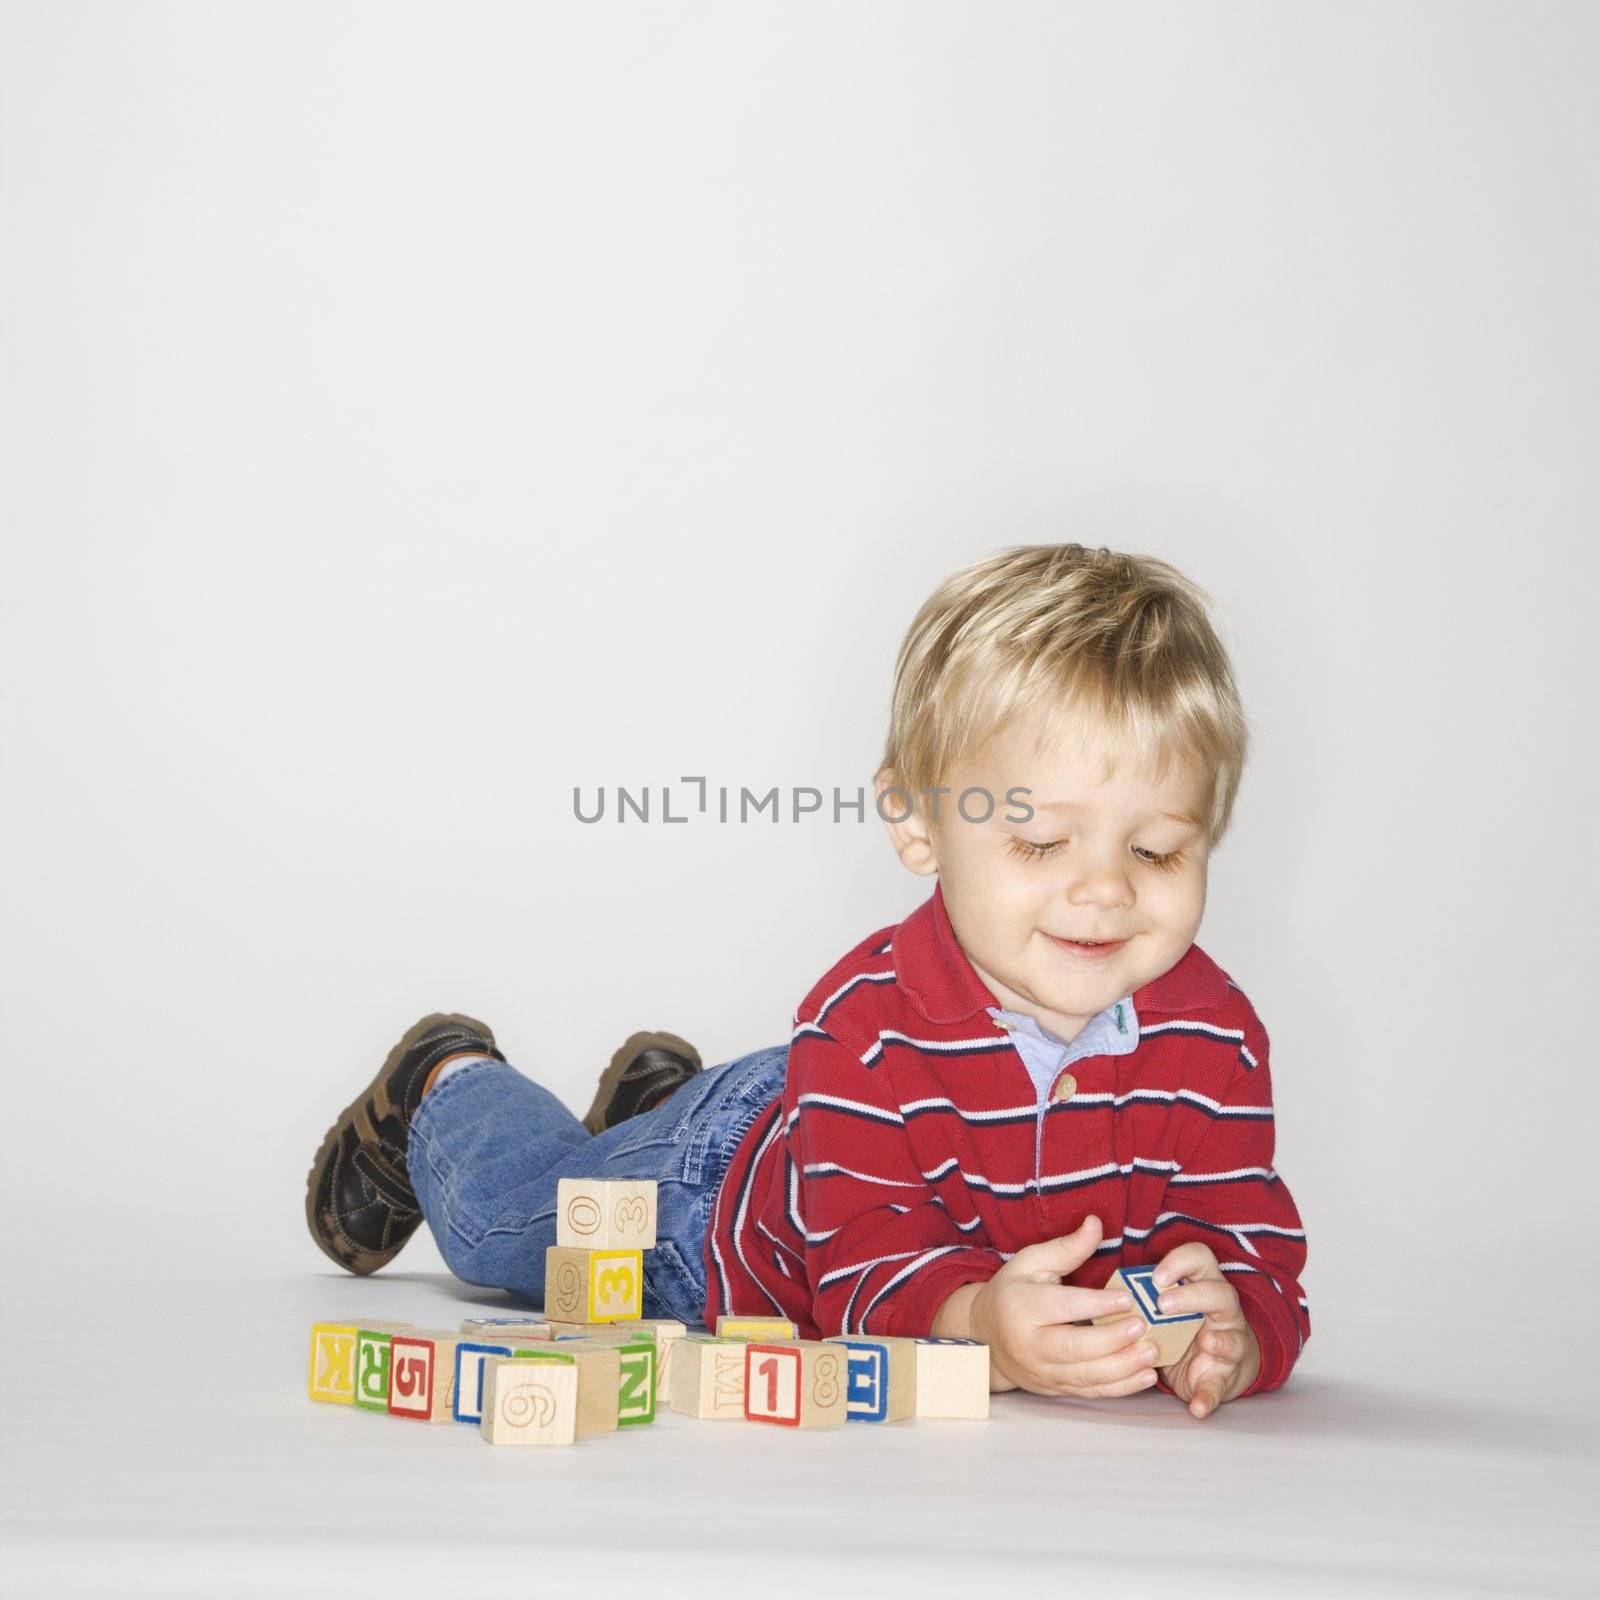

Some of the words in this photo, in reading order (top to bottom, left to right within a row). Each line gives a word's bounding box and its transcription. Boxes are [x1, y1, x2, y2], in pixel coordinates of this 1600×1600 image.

[614, 1195, 649, 1234] 3
[598, 1265, 635, 1305] 3
[318, 1336, 354, 1390] K
[361, 1343, 390, 1399] R
[395, 1356, 426, 1398] 5
[758, 1357, 779, 1412] 1
[812, 1353, 840, 1408] 8
